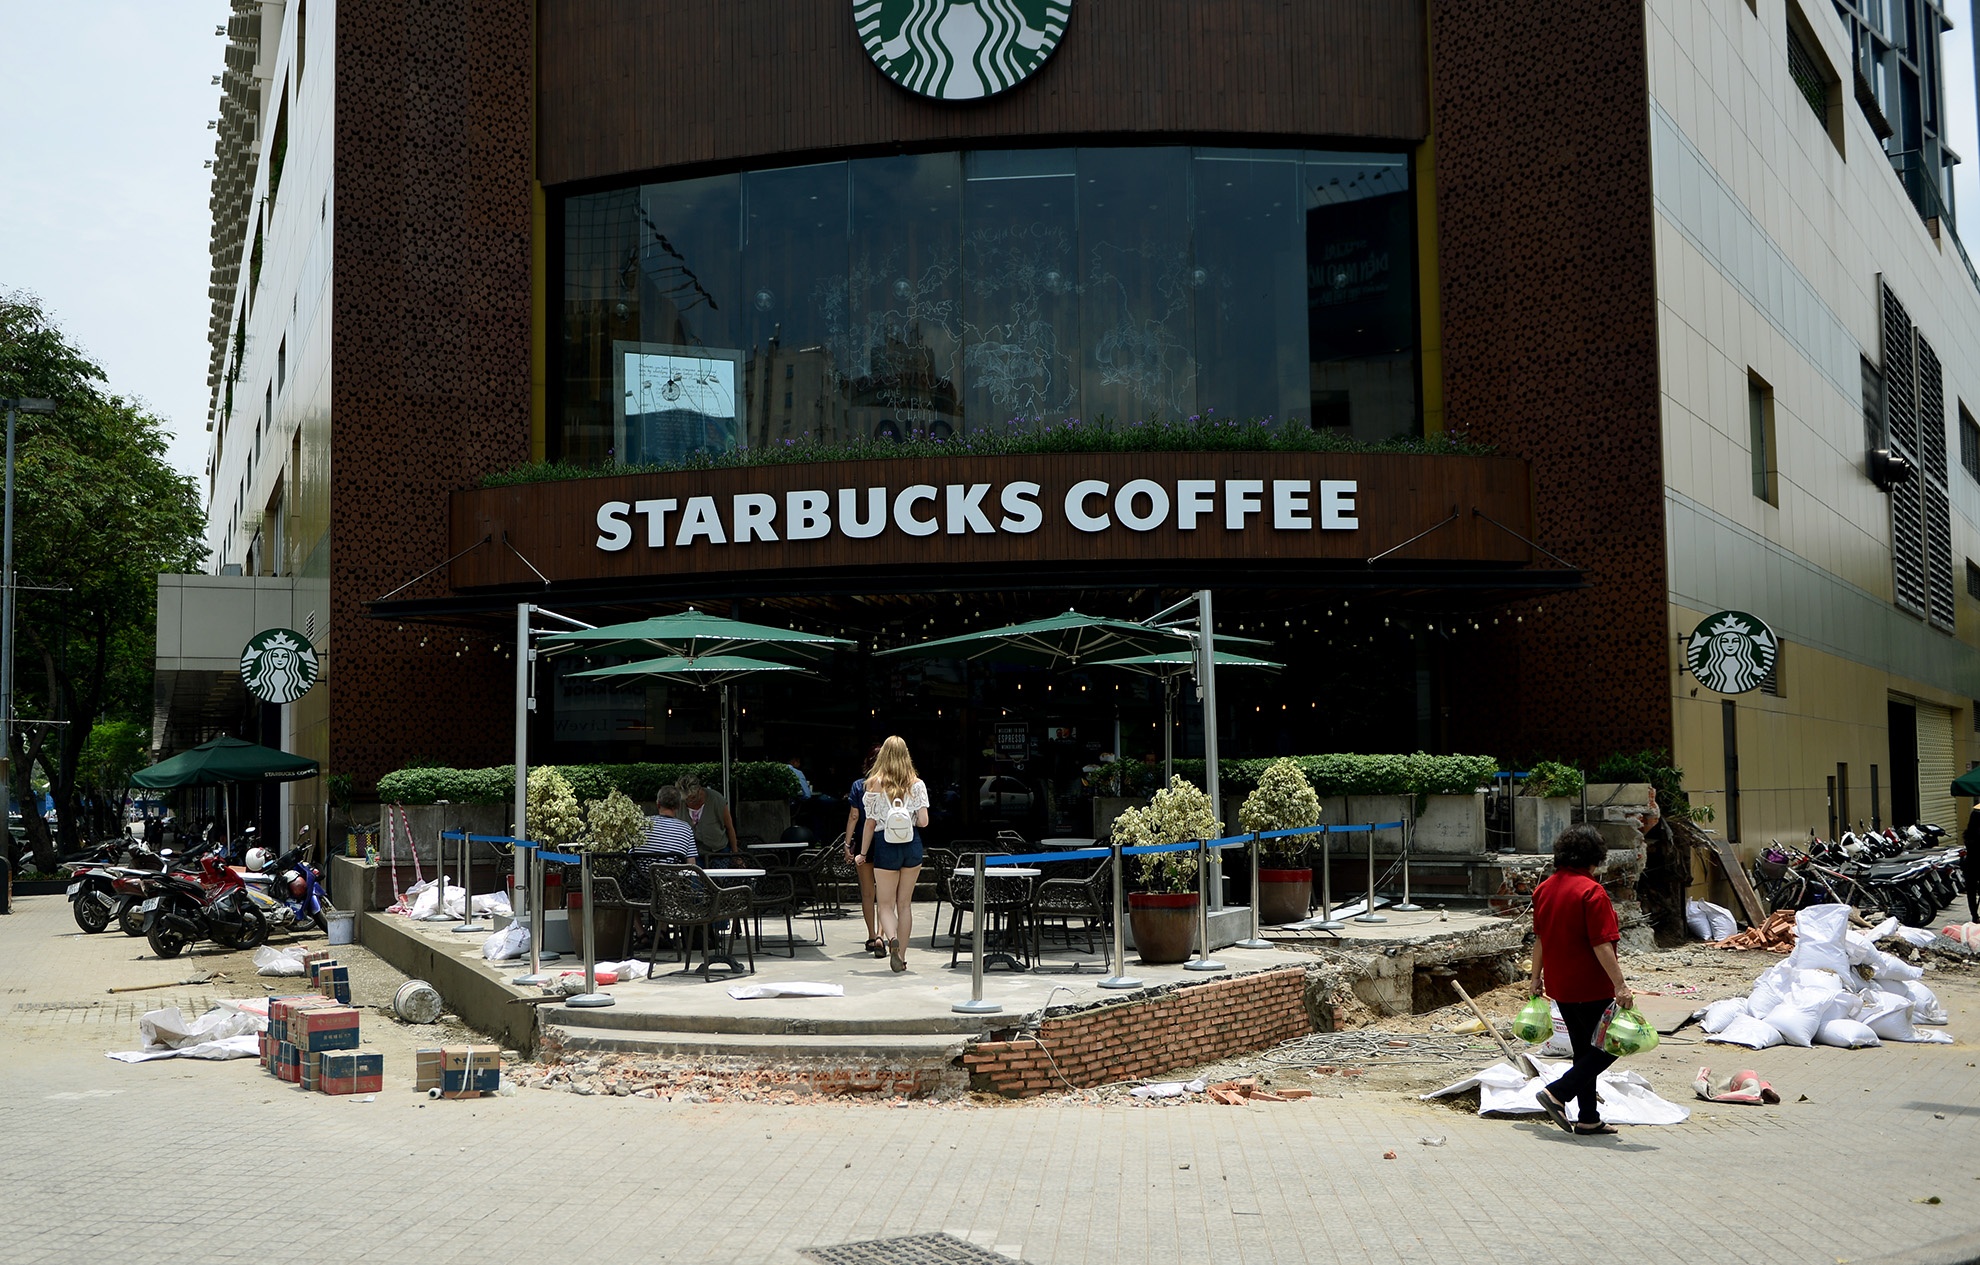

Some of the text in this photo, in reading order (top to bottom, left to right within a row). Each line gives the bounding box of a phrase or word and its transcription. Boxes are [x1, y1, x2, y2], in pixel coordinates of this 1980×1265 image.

[596, 478, 1359, 552] STARBUCKS COFFEE
[998, 733, 1026, 744] ESPRESSO
